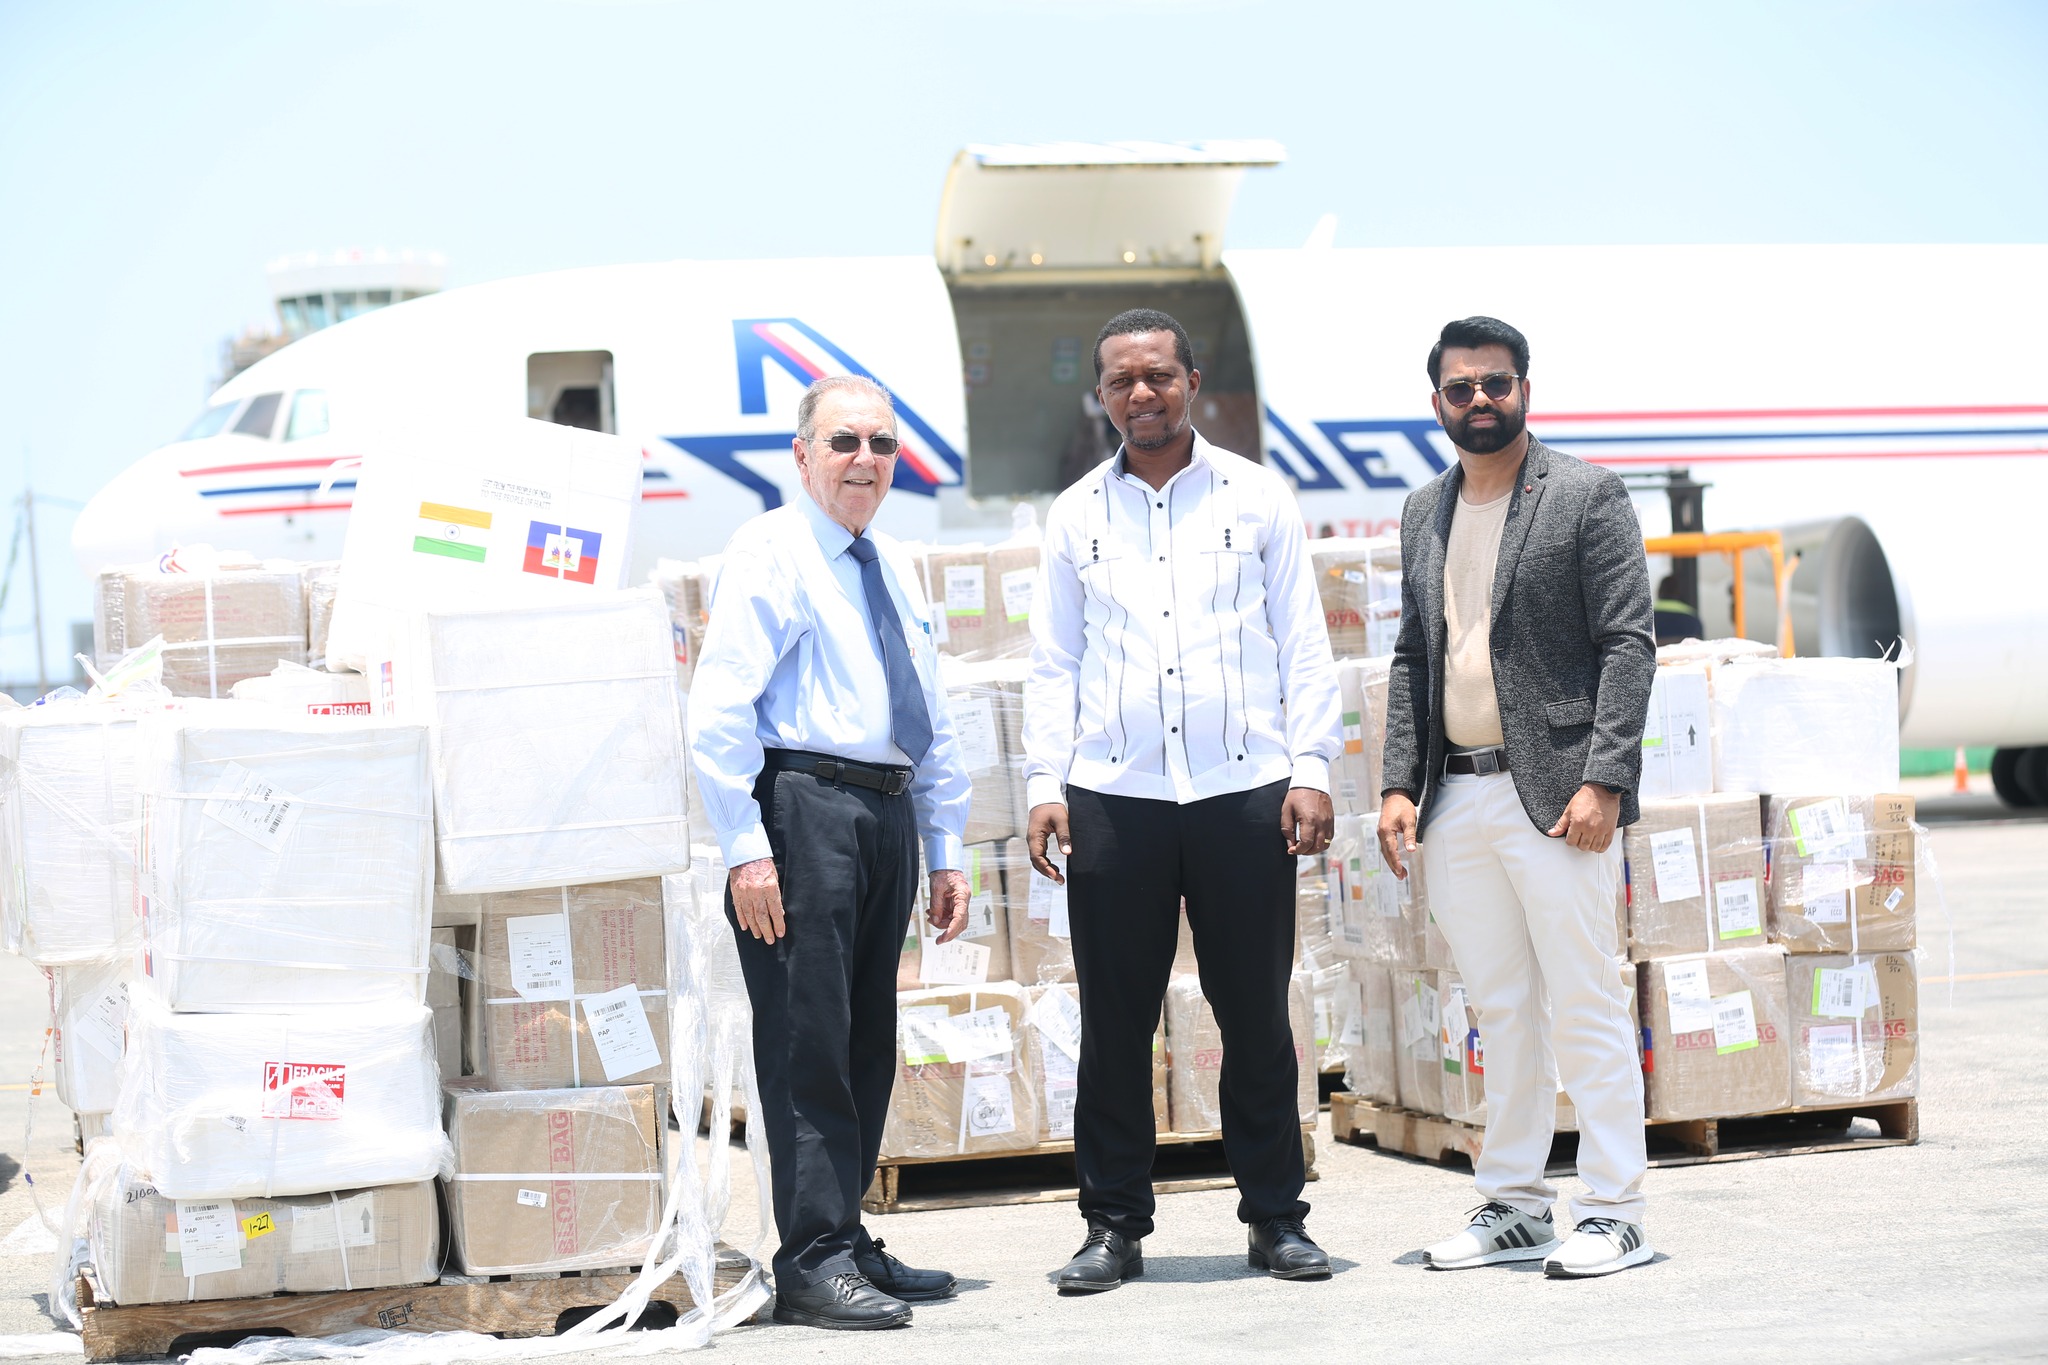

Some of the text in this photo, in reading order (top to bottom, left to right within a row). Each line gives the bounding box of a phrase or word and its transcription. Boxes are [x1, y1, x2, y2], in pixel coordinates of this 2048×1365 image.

[503, 493, 525, 505] PEOPLE
[1803, 906, 1817, 917] PAP
[597, 1028, 611, 1037] PAP
[1676, 1025, 1777, 1048] BLO AG
[552, 1111, 571, 1162] BAG
[555, 1170, 575, 1254] BLOOD
